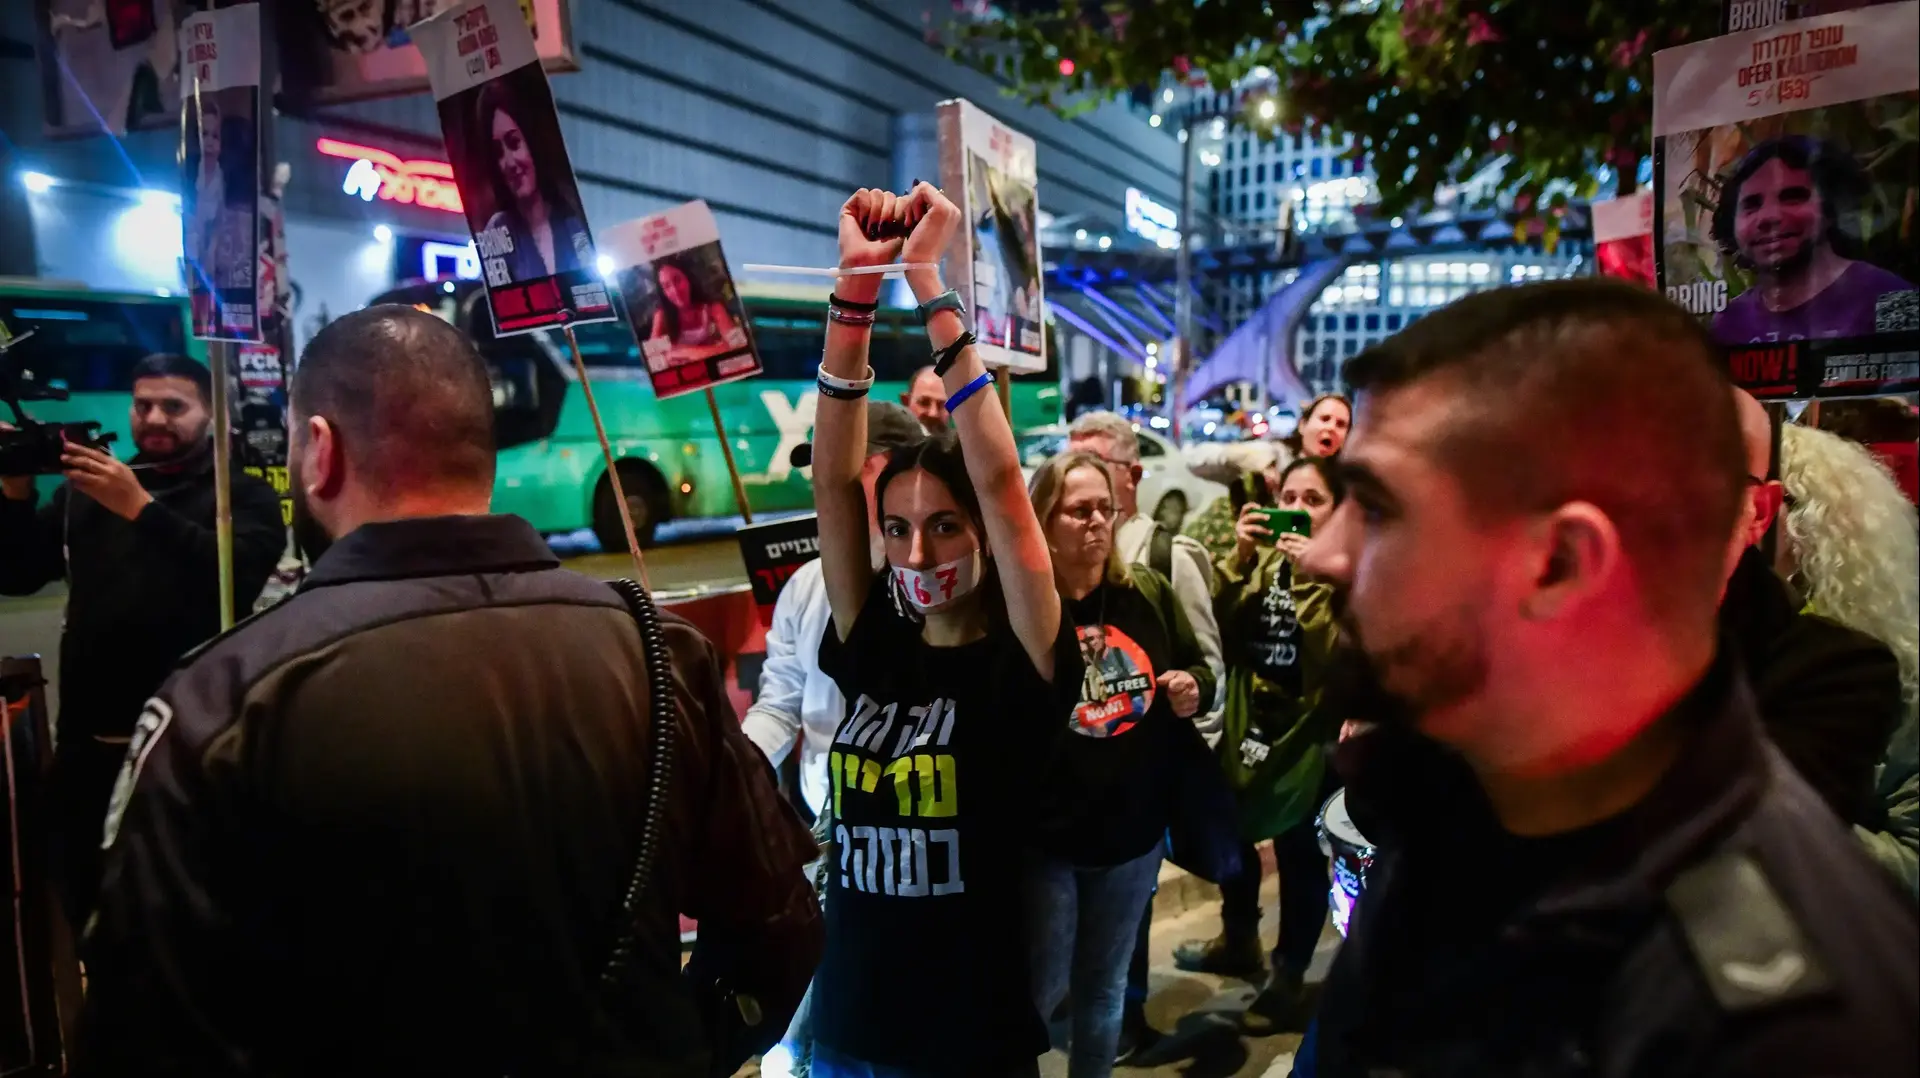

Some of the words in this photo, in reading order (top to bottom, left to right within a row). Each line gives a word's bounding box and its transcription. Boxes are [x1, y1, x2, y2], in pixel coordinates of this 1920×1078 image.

[1729, 0, 1787, 31] BRING
[1805, 25, 1844, 50] עופר
[1737, 62, 1772, 87] OFER
[1776, 44, 1858, 79] KALDERON
[475, 225, 514, 259] BRING
[484, 256, 512, 288] HER
[1730, 343, 1797, 382] NOW!
[1117, 677, 1148, 693] FREE
[1086, 700, 1125, 721] NOW!
[831, 751, 958, 820] עדיין
[835, 824, 965, 897] בעזה?
